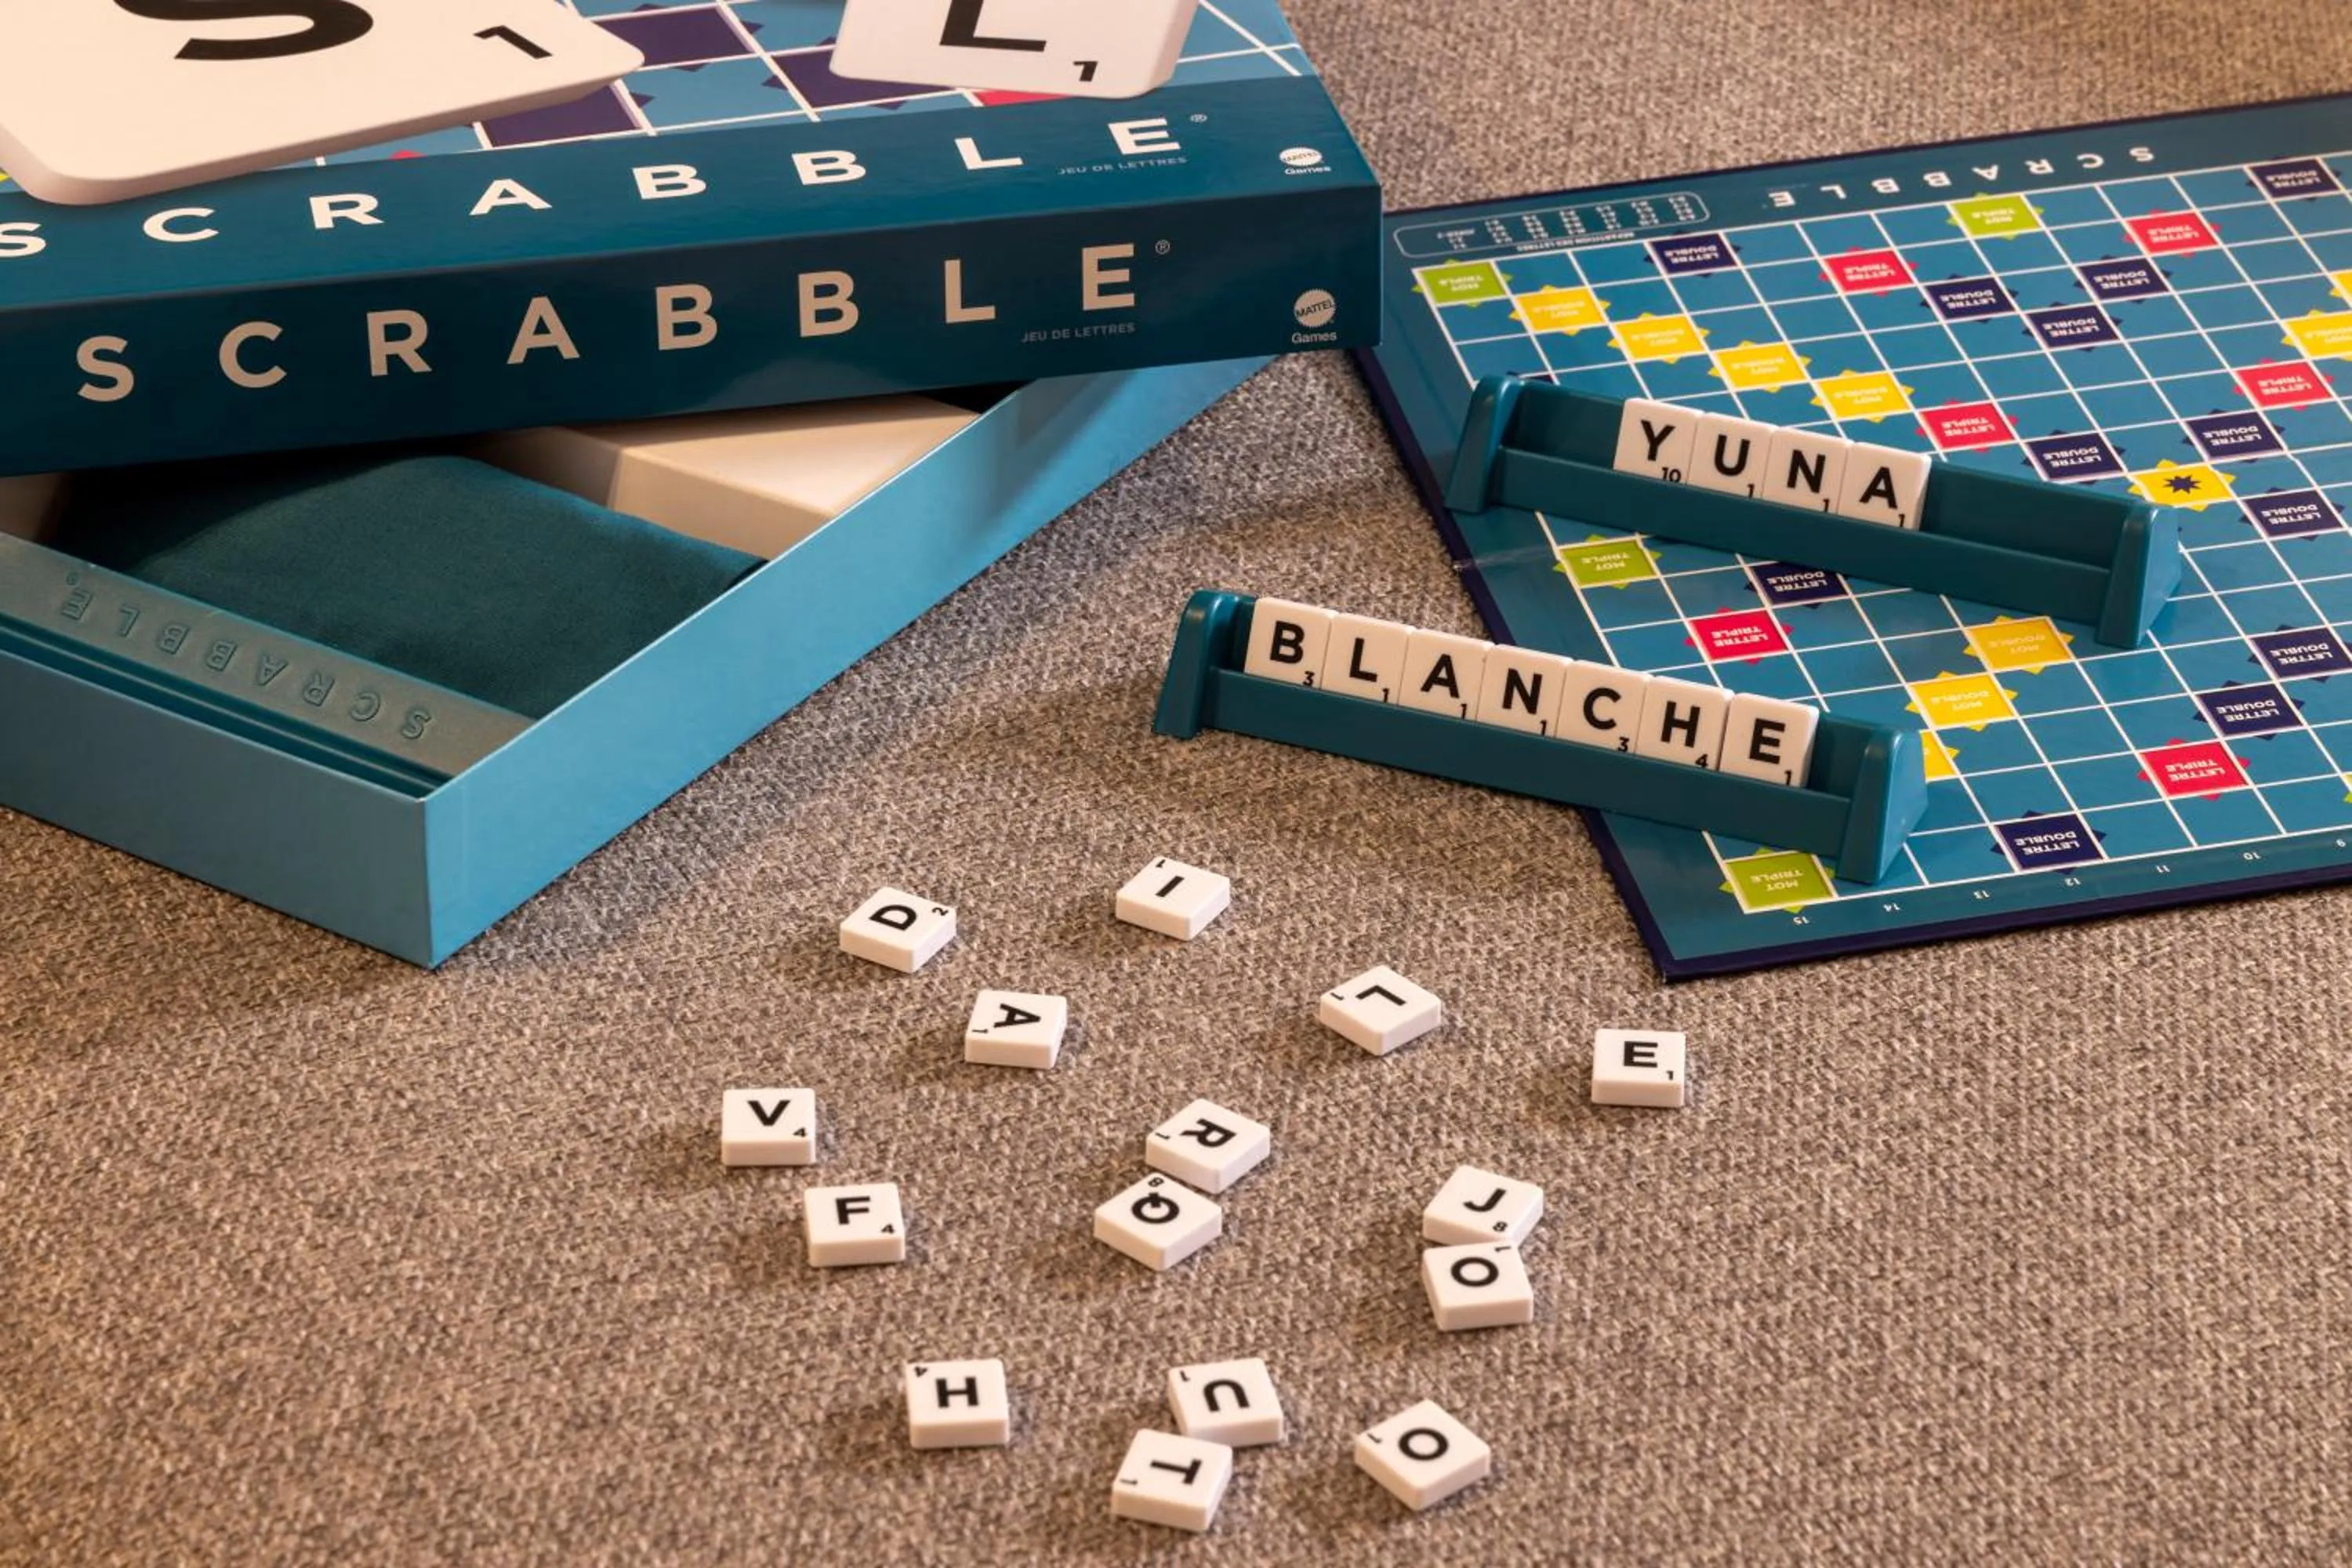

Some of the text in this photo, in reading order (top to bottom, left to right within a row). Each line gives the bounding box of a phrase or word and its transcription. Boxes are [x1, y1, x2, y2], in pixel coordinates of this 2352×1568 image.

[474, 24, 553, 59] 1
[1073, 60, 1098, 82] 1
[1118, 156, 1188, 169] LETTRES
[1285, 165, 1331, 175] Games
[1769, 147, 2154, 208] SCRABBLE
[1664, 245, 1718, 257] DOUBLE
[1671, 252, 1719, 263] LETTRE
[2093, 270, 2147, 282] DOUBLE
[2100, 278, 2150, 289] LETTRE
[1940, 289, 1994, 303] DOUBLE
[1947, 296, 1997, 309] LETTRE
[1296, 299, 1334, 317] MATTEL
[2042, 317, 2096, 330] DOUBLE
[1022, 321, 1136, 343] JEU DE LETTRES
[1291, 332, 1337, 344] Games
[2049, 325, 2100, 338] LETTRE
[2258, 376, 2305, 387] TRIPLE
[2263, 383, 2313, 395] LETTRE
[1941, 416, 1990, 429] TRIPLE
[1944, 424, 1996, 437] LETTRE
[2203, 425, 2259, 438] DOUBLE
[2210, 434, 2263, 446] LETTRE
[2042, 446, 2099, 461] DOUBLE
[1640, 419, 1899, 510] YUNA
[2050, 453, 2103, 469] LETTRE
[1661, 466, 1682, 483] 10
[1747, 484, 1755, 499] 1
[1822, 499, 1830, 513] 1
[2261, 504, 2319, 517] DOUBLE
[1897, 514, 1905, 528] 1
[2268, 512, 2321, 524] LETTRE
[1581, 553, 1631, 564] TRIPLE
[1595, 561, 1627, 572] MOT
[1765, 571, 1825, 585] DOUBLE
[1774, 579, 1829, 592] LETTRE
[1711, 626, 1764, 639] TRIPLE
[1714, 633, 1770, 647] LETTRE
[2270, 642, 2329, 655] DOUBLE
[62, 588, 431, 740] SCRABBLE
[2278, 651, 2333, 666] LETTRE
[1303, 670, 1315, 687] 3
[1269, 621, 1786, 764] BLANCHE
[1381, 688, 1390, 704] 1
[1461, 703, 1468, 720] 1
[2216, 699, 2277, 714] DOUBLE
[2225, 708, 2280, 722] LETTRE
[1540, 720, 1548, 736] 1
[1617, 737, 1629, 753] 3
[1695, 753, 1708, 769] 4
[2165, 758, 2218, 773] TRIPLE
[1784, 770, 1793, 786] 1
[2169, 767, 2227, 782] LETTRE
[2014, 830, 2078, 846] DOUBLE
[2022, 840, 2081, 855] LETTRE
[1155, 858, 1168, 869] 1
[1750, 869, 1803, 884] TRIPLE
[1155, 875, 1185, 898] I
[1766, 880, 1798, 892] MOT
[869, 904, 916, 931] D
[931, 907, 949, 916] 2
[1329, 992, 1345, 1001] 1
[1356, 984, 1406, 1007] L
[993, 1003, 1041, 1029] A
[1623, 1040, 1659, 1069] E
[1665, 1070, 1674, 1080] 1
[746, 1100, 791, 1127] V
[793, 1127, 808, 1138] 4
[1154, 1131, 1171, 1141] 1
[1179, 1118, 1237, 1148] R
[1148, 1177, 1165, 1188] 8
[1463, 1187, 1507, 1213] J
[835, 1196, 871, 1225] F
[1131, 1192, 1180, 1225] Q
[880, 1224, 895, 1234] 4
[1492, 1221, 1508, 1233] 8
[1450, 1257, 1500, 1287] O
[913, 1366, 929, 1377] 4
[1178, 1370, 1190, 1382] 1
[935, 1376, 980, 1409] H
[1203, 1377, 1251, 1413] U
[1367, 1432, 1384, 1444] 1
[1398, 1427, 1450, 1461] O
[1150, 1458, 1203, 1485] T
[1120, 1478, 1139, 1486] 1
